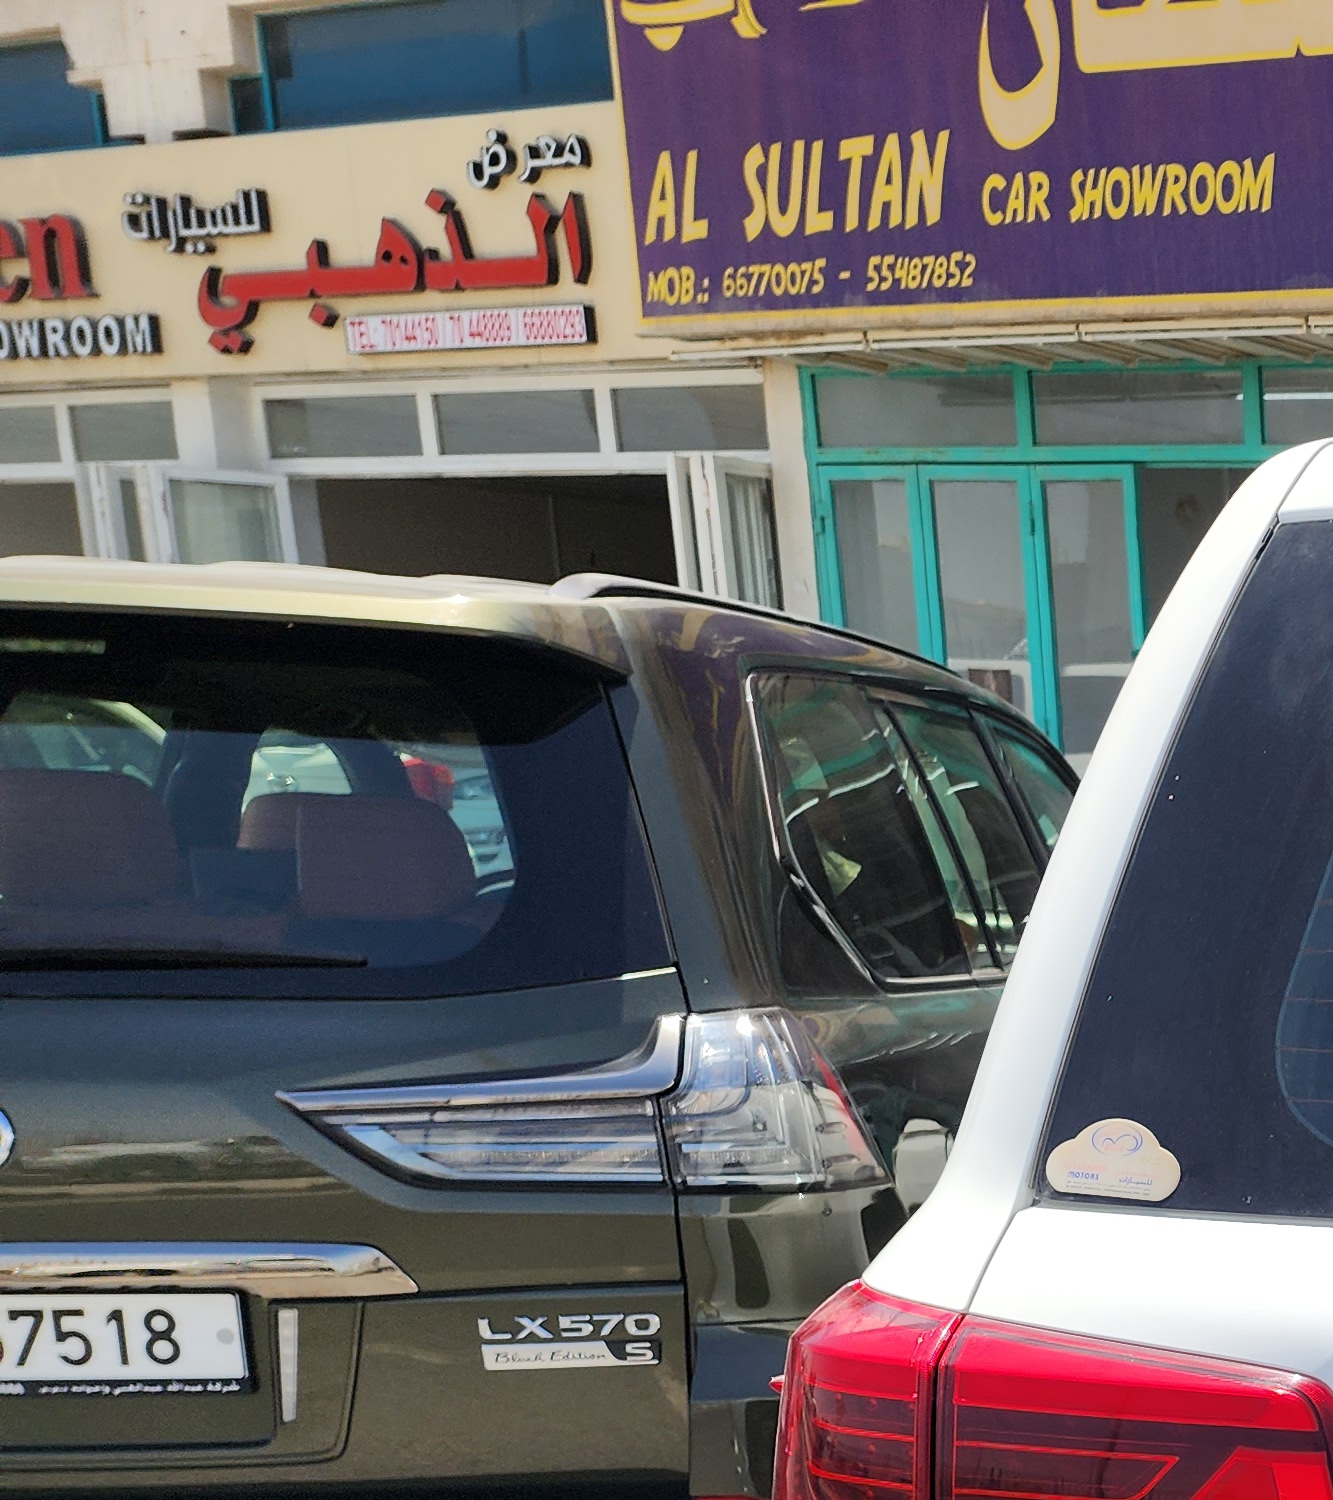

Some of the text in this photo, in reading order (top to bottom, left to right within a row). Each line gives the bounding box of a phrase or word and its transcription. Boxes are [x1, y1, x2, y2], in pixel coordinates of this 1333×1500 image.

[467, 129, 590, 190] معرض
[645, 129, 1277, 246] AL SULTAN CAR SHOWROOM
[121, 187, 270, 254] للسيارات
[198, 189, 592, 355] الذهبي
[721, 257, 826, 298] 66770075
[866, 251, 977, 293] 55487852
[1067, 1170, 1100, 1181] MOTORS
[0, 1309, 181, 1366] 7518
[624, 1342, 655, 1362] S
